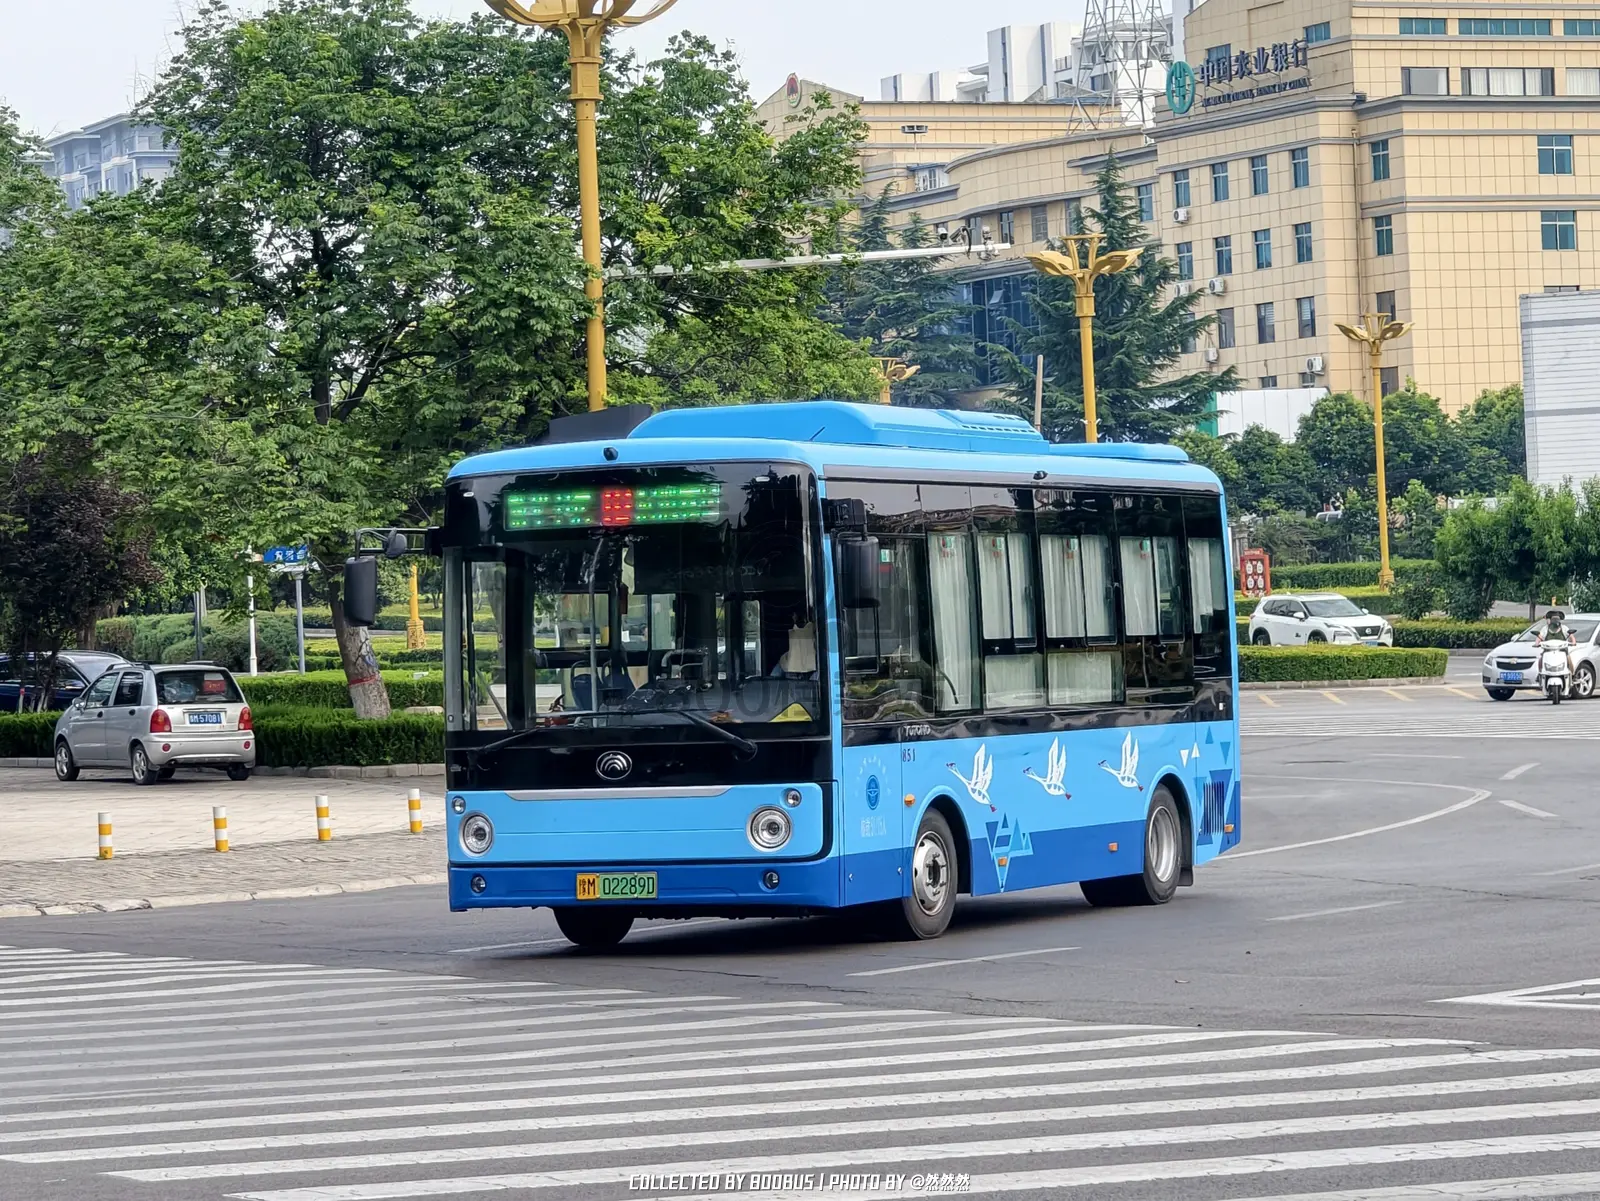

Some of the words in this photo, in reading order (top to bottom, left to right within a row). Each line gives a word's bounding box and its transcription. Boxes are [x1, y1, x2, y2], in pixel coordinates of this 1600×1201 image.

[1200, 39, 1308, 86] 中国农业银行
[903, 748, 915, 762] 851
